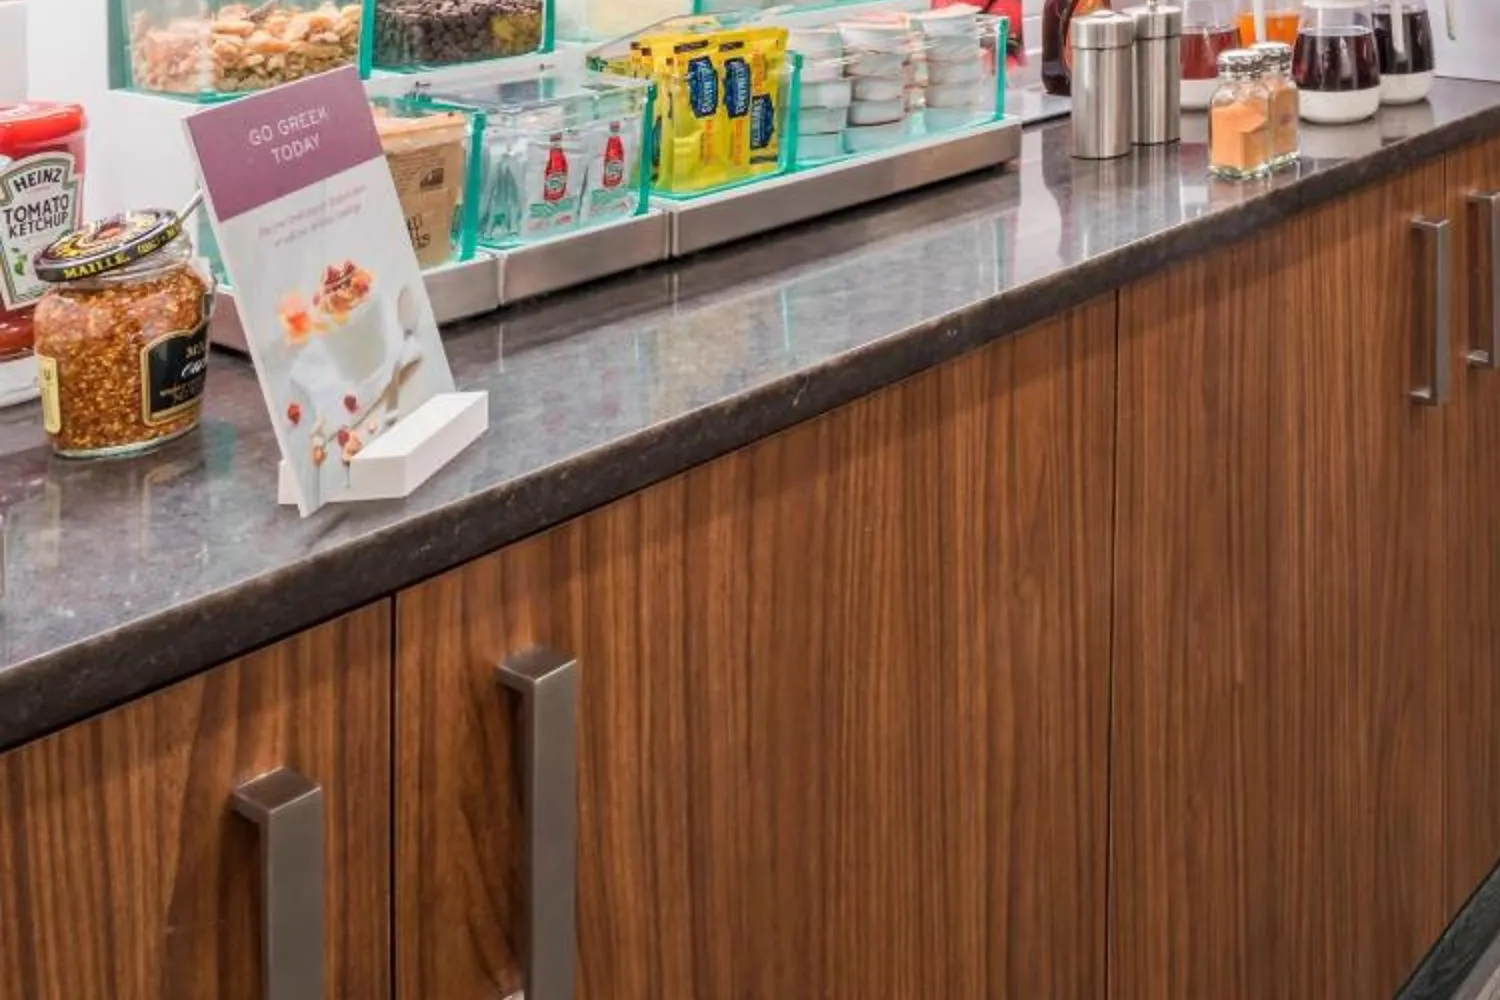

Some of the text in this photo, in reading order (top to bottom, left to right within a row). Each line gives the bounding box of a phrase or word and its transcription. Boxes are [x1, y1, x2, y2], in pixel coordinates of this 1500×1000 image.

[249, 106, 329, 146] GO GREEK
[271, 132, 320, 164] TODAY
[13, 167, 62, 192] HEINZ
[4, 194, 69, 224] TOMATO
[9, 212, 68, 239] KETCHUP
